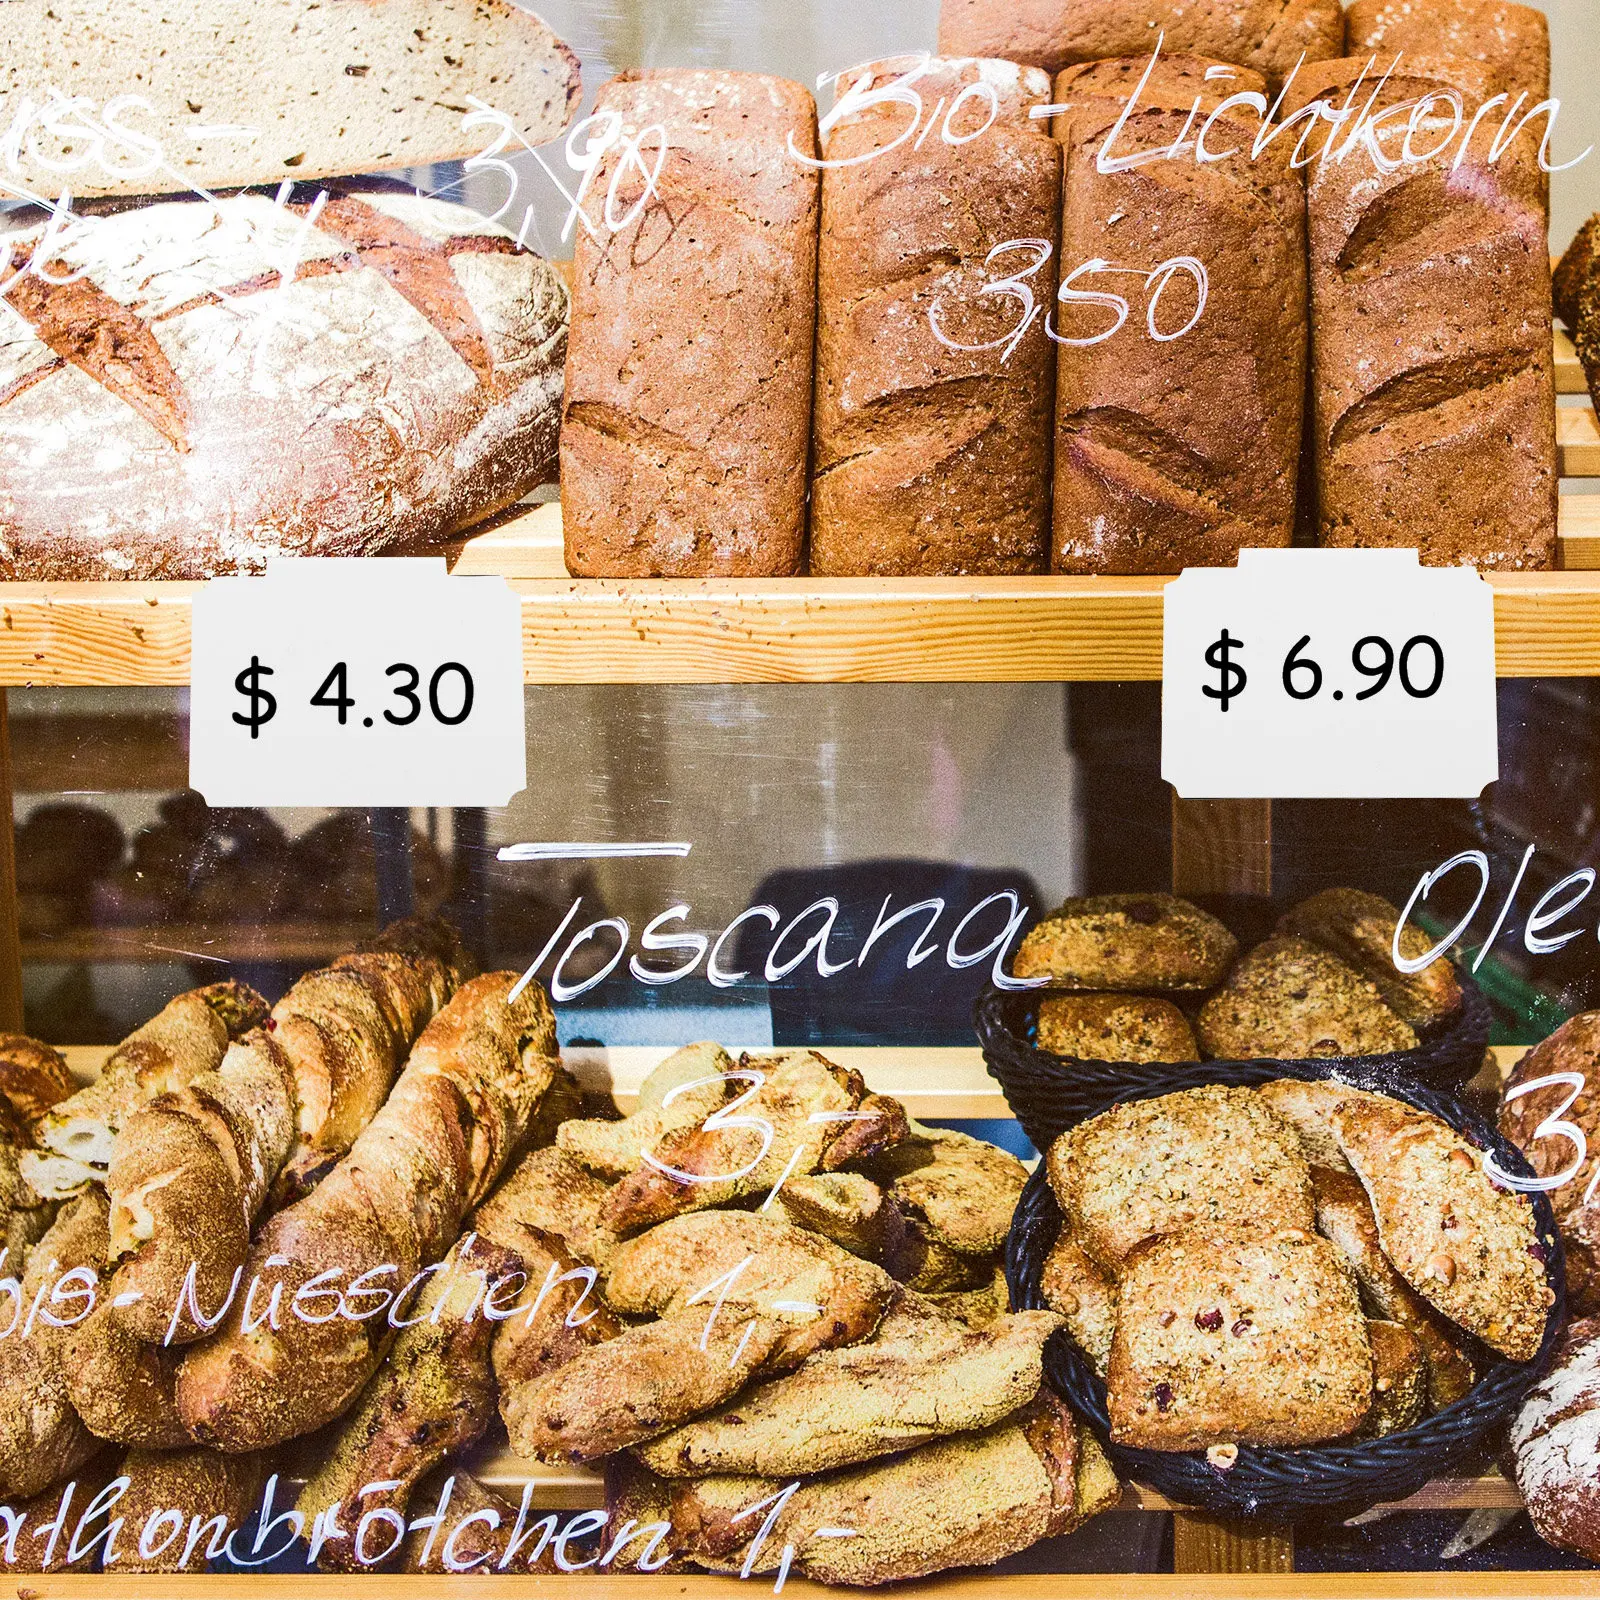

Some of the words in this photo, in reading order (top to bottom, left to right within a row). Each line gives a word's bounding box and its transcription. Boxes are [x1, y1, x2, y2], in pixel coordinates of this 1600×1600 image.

[929, 237, 1210, 364] 3,50
[231, 655, 278, 740] $
[309, 661, 475, 726] 4.30
[1201, 628, 1248, 713] $
[1281, 633, 1446, 702] 6.90
[496, 841, 1053, 1004] Toscana
[1392, 842, 1600, 975] Ole
